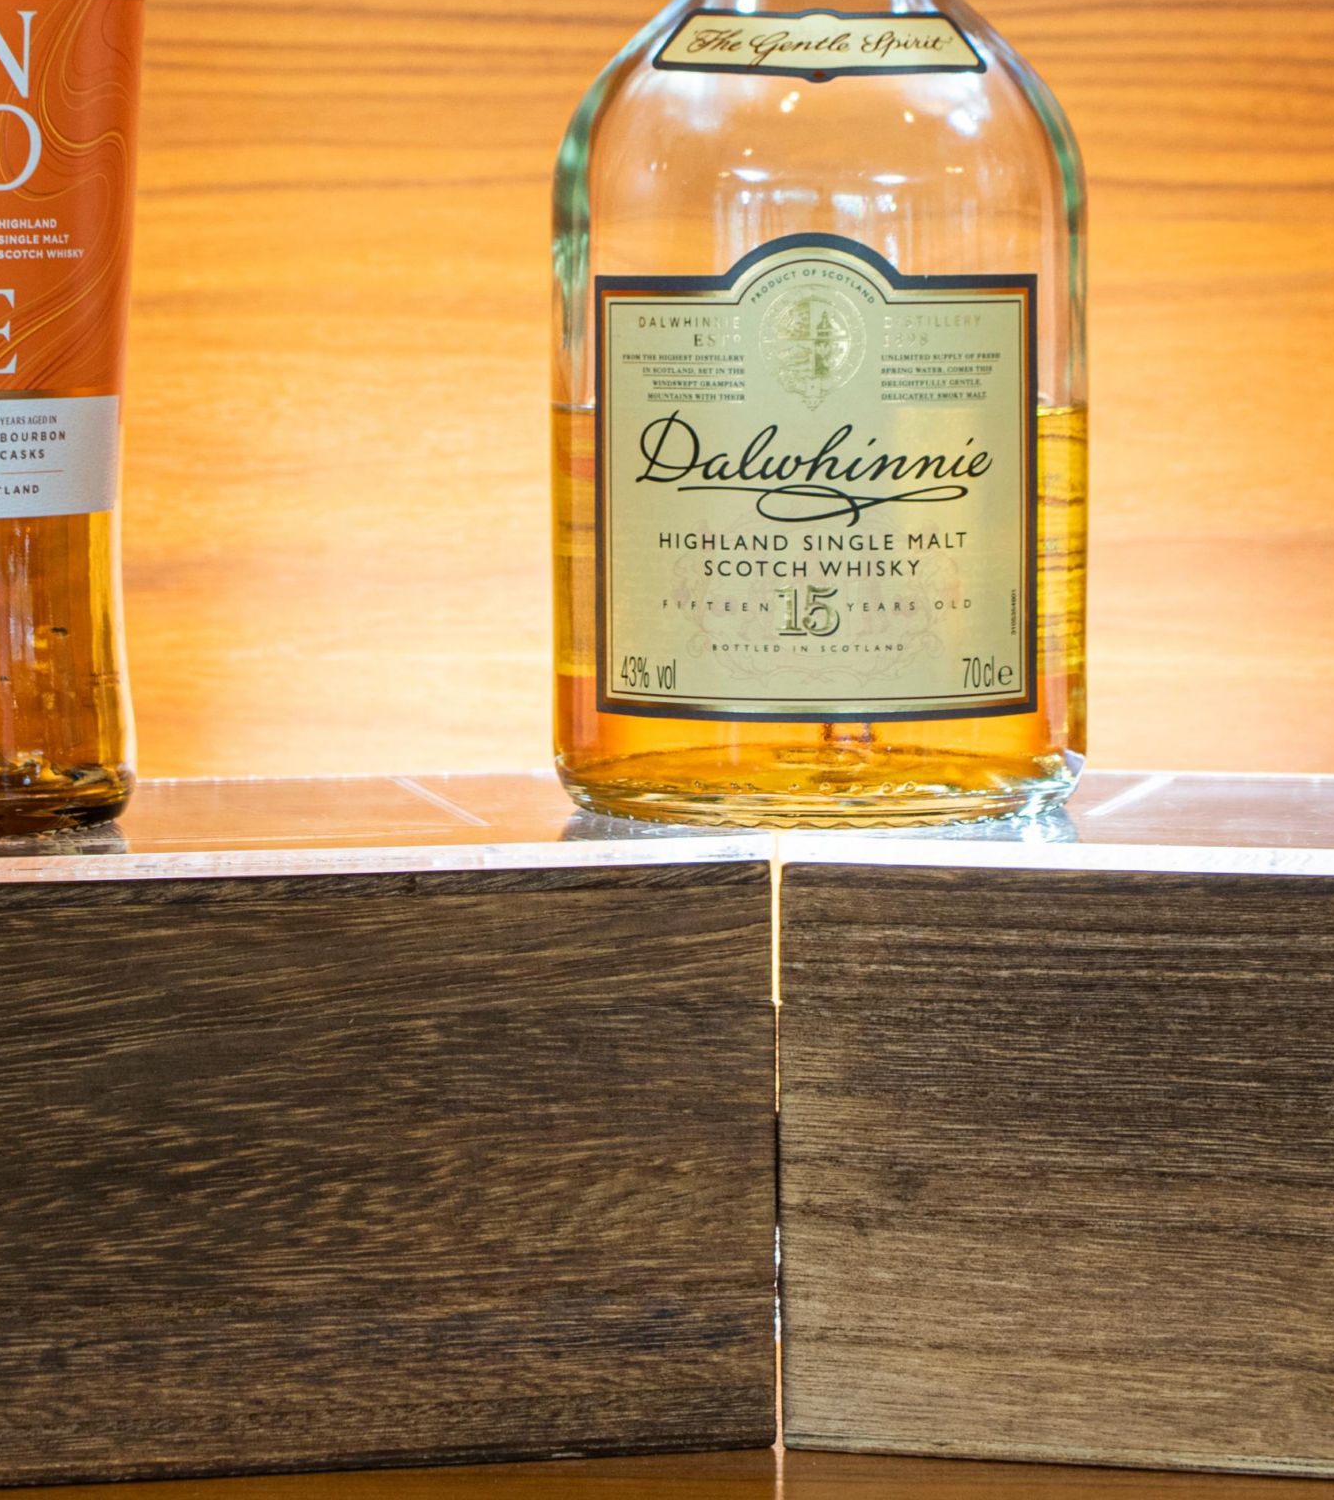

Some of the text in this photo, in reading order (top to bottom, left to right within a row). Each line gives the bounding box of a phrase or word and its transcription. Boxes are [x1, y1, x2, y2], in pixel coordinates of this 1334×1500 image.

[686, 29, 953, 70] The Gentle Spirit
[43, 233, 70, 245] MALT
[47, 248, 85, 259] WHISKY
[751, 269, 875, 304] PRODUCT OF SCOTLAND
[695, 354, 745, 362] DISTILLERY
[728, 367, 745, 375] THE
[0, 414, 58, 426] YEARS AGED IN
[0, 431, 66, 443] BOURBON
[635, 409, 994, 483] Dalwhinnie
[0, 449, 46, 461] CASKS
[659, 532, 967, 551] HIGHLAND SINGLE MALT
[704, 560, 921, 578] SCOTCH WHISKY
[663, 584, 972, 637] FIFTEEN 15 YEARS OLD
[712, 644, 904, 652] BOTTLED IN SCOTLAND
[620, 656, 677, 689] 43% vol
[962, 656, 996, 689] 70cl
